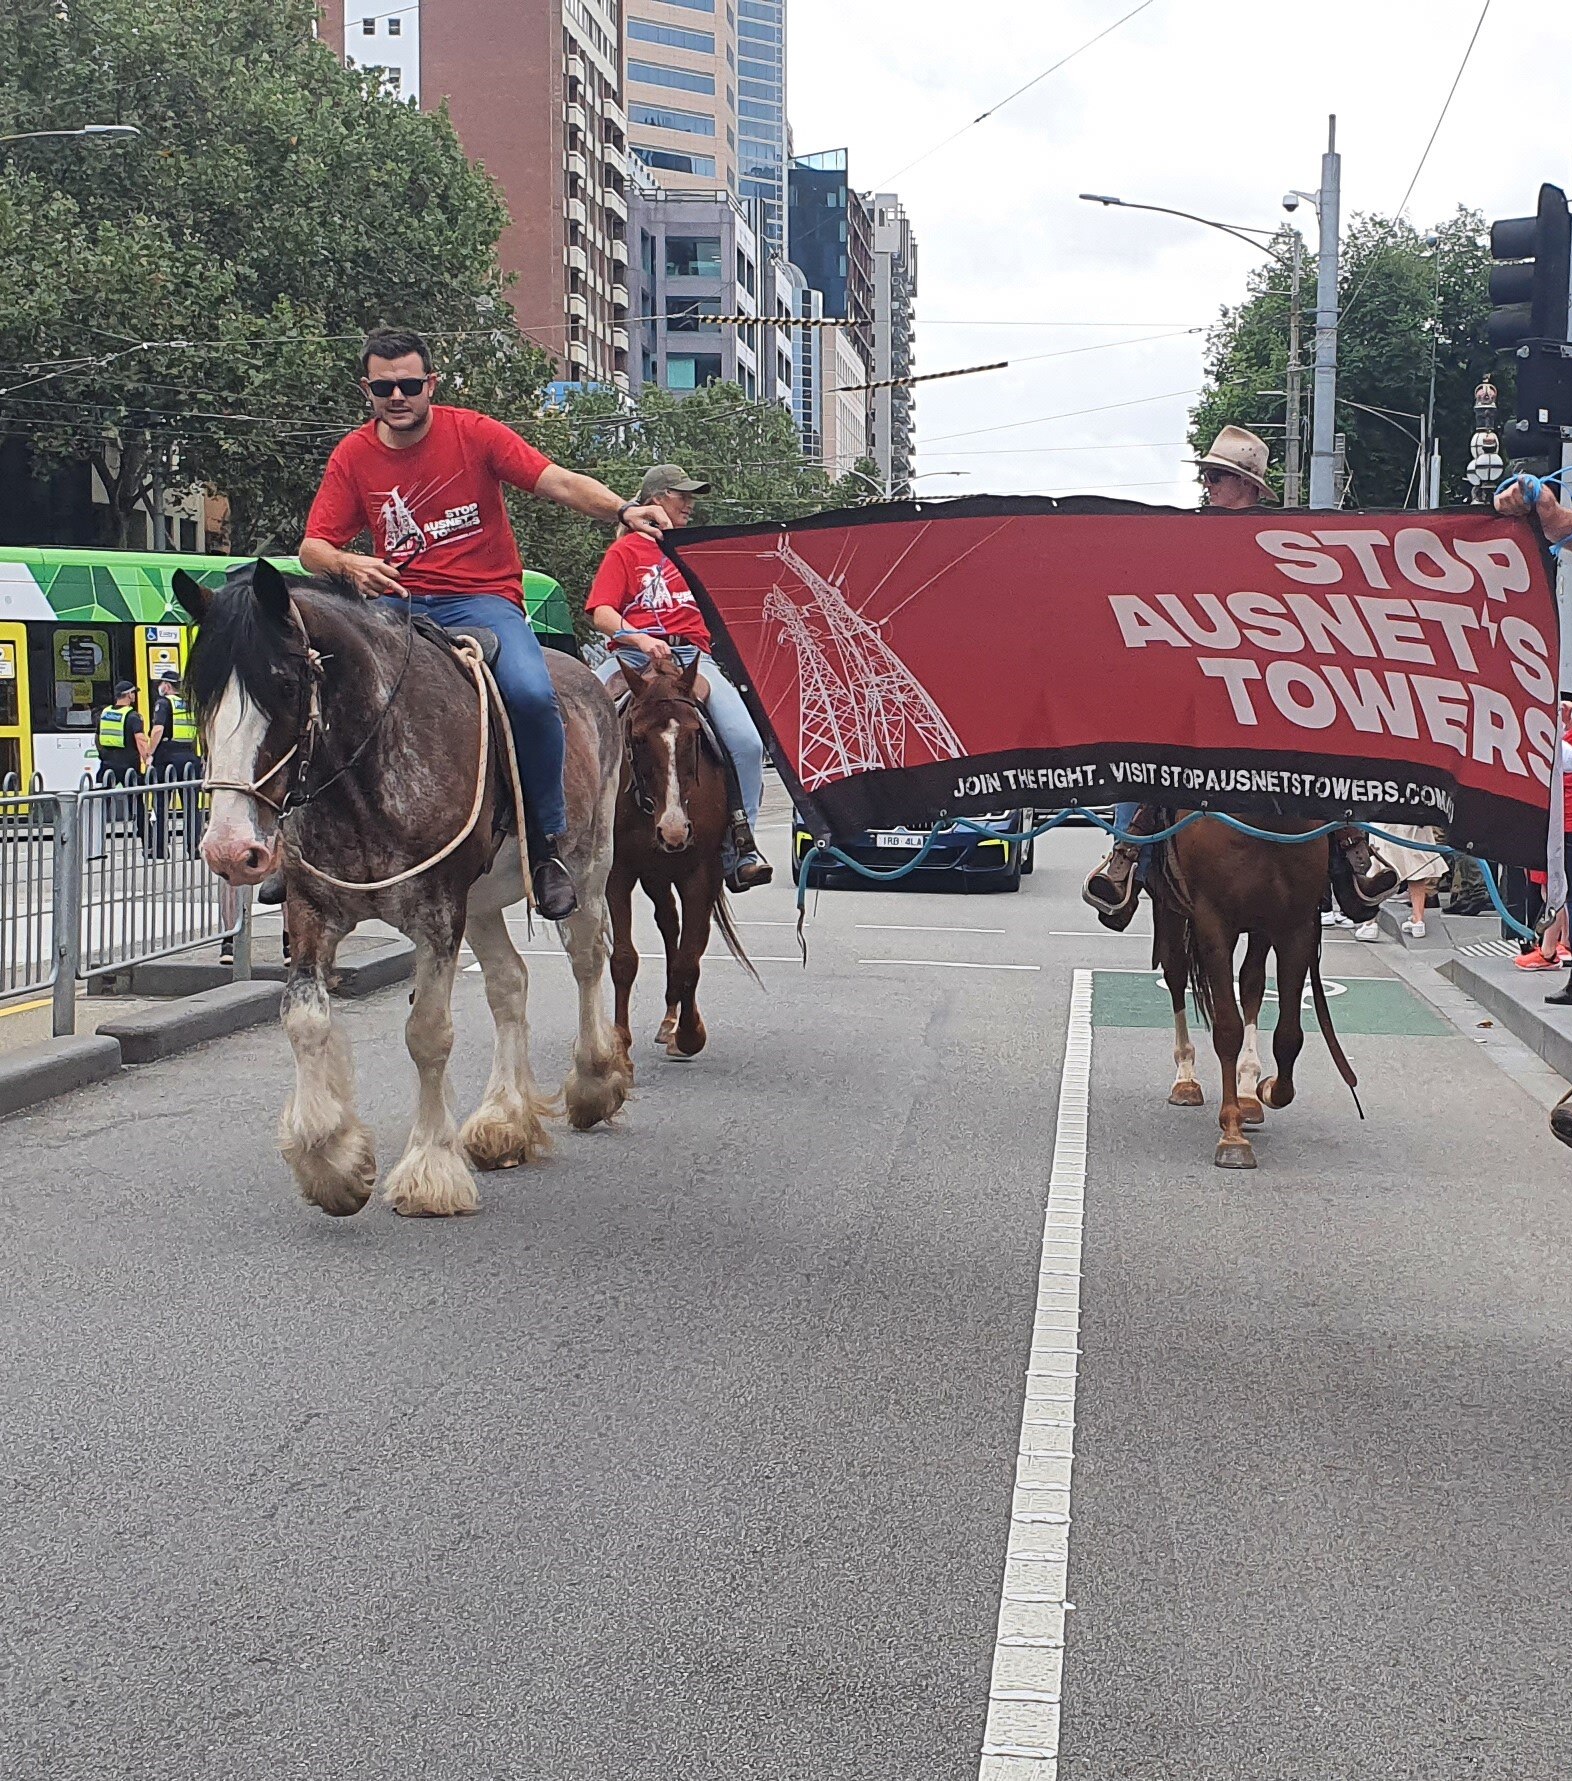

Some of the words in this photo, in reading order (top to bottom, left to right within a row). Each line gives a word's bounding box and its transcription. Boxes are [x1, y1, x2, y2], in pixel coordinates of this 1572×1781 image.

[445, 502, 478, 519] STOP
[1256, 528, 1531, 603] STOP
[1108, 592, 1556, 705] AUSNET'S
[1198, 657, 1556, 789] TOWERS
[953, 772, 1002, 798] JOIN
[1003, 767, 1037, 791] THE
[1109, 761, 1157, 785] VISIT
